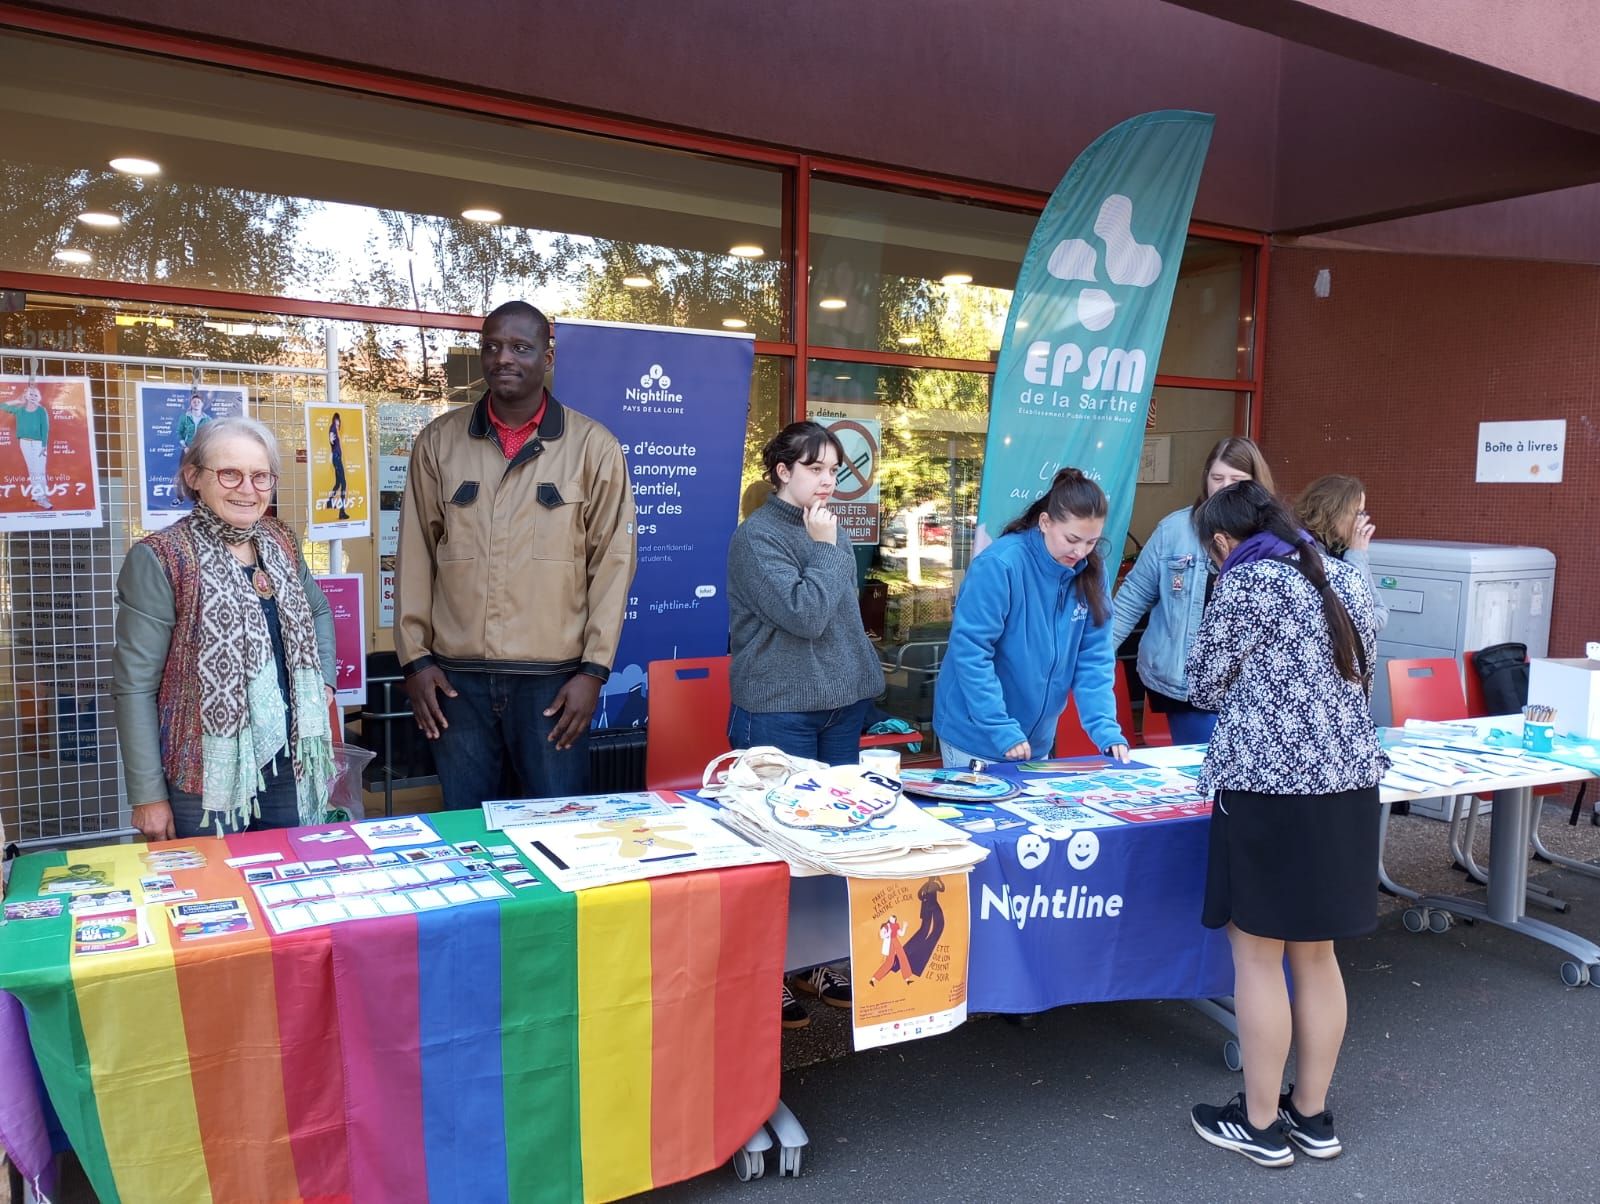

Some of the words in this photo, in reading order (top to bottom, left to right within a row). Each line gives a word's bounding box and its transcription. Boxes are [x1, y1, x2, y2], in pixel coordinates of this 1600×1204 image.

[1023, 340, 1147, 394] EPSM
[625, 387, 683, 404] Nightline
[1020, 388, 1044, 405] de
[1052, 391, 1070, 408] la
[1079, 394, 1137, 413] Sarthe
[816, 407, 847, 418] détente
[634, 441, 697, 456] d'écoute
[1485, 441, 1513, 453] Boîte
[1516, 441, 1524, 452] à
[1527, 440, 1559, 453] livres
[633, 464, 697, 479] anonyme
[4, 475, 26, 484] Sylvie
[47, 474, 54, 482] le
[55, 473, 71, 482] vélo
[21, 483, 70, 498] VOUS
[75, 482, 87, 497] ?
[153, 484, 175, 497] ET
[1010, 487, 1031, 500] au
[315, 498, 330, 511] ET
[330, 497, 356, 510] VOUS
[657, 502, 682, 515] des
[847, 503, 867, 515] ÊTES
[855, 517, 877, 526] ZONE
[653, 543, 694, 552] confidential
[629, 597, 639, 606] 12
[649, 599, 700, 614] nightline.fr
[629, 611, 638, 620] 13
[980, 883, 1124, 931] Nightline
[926, 971, 933, 979] LE
[937, 972, 950, 982] SOIR
